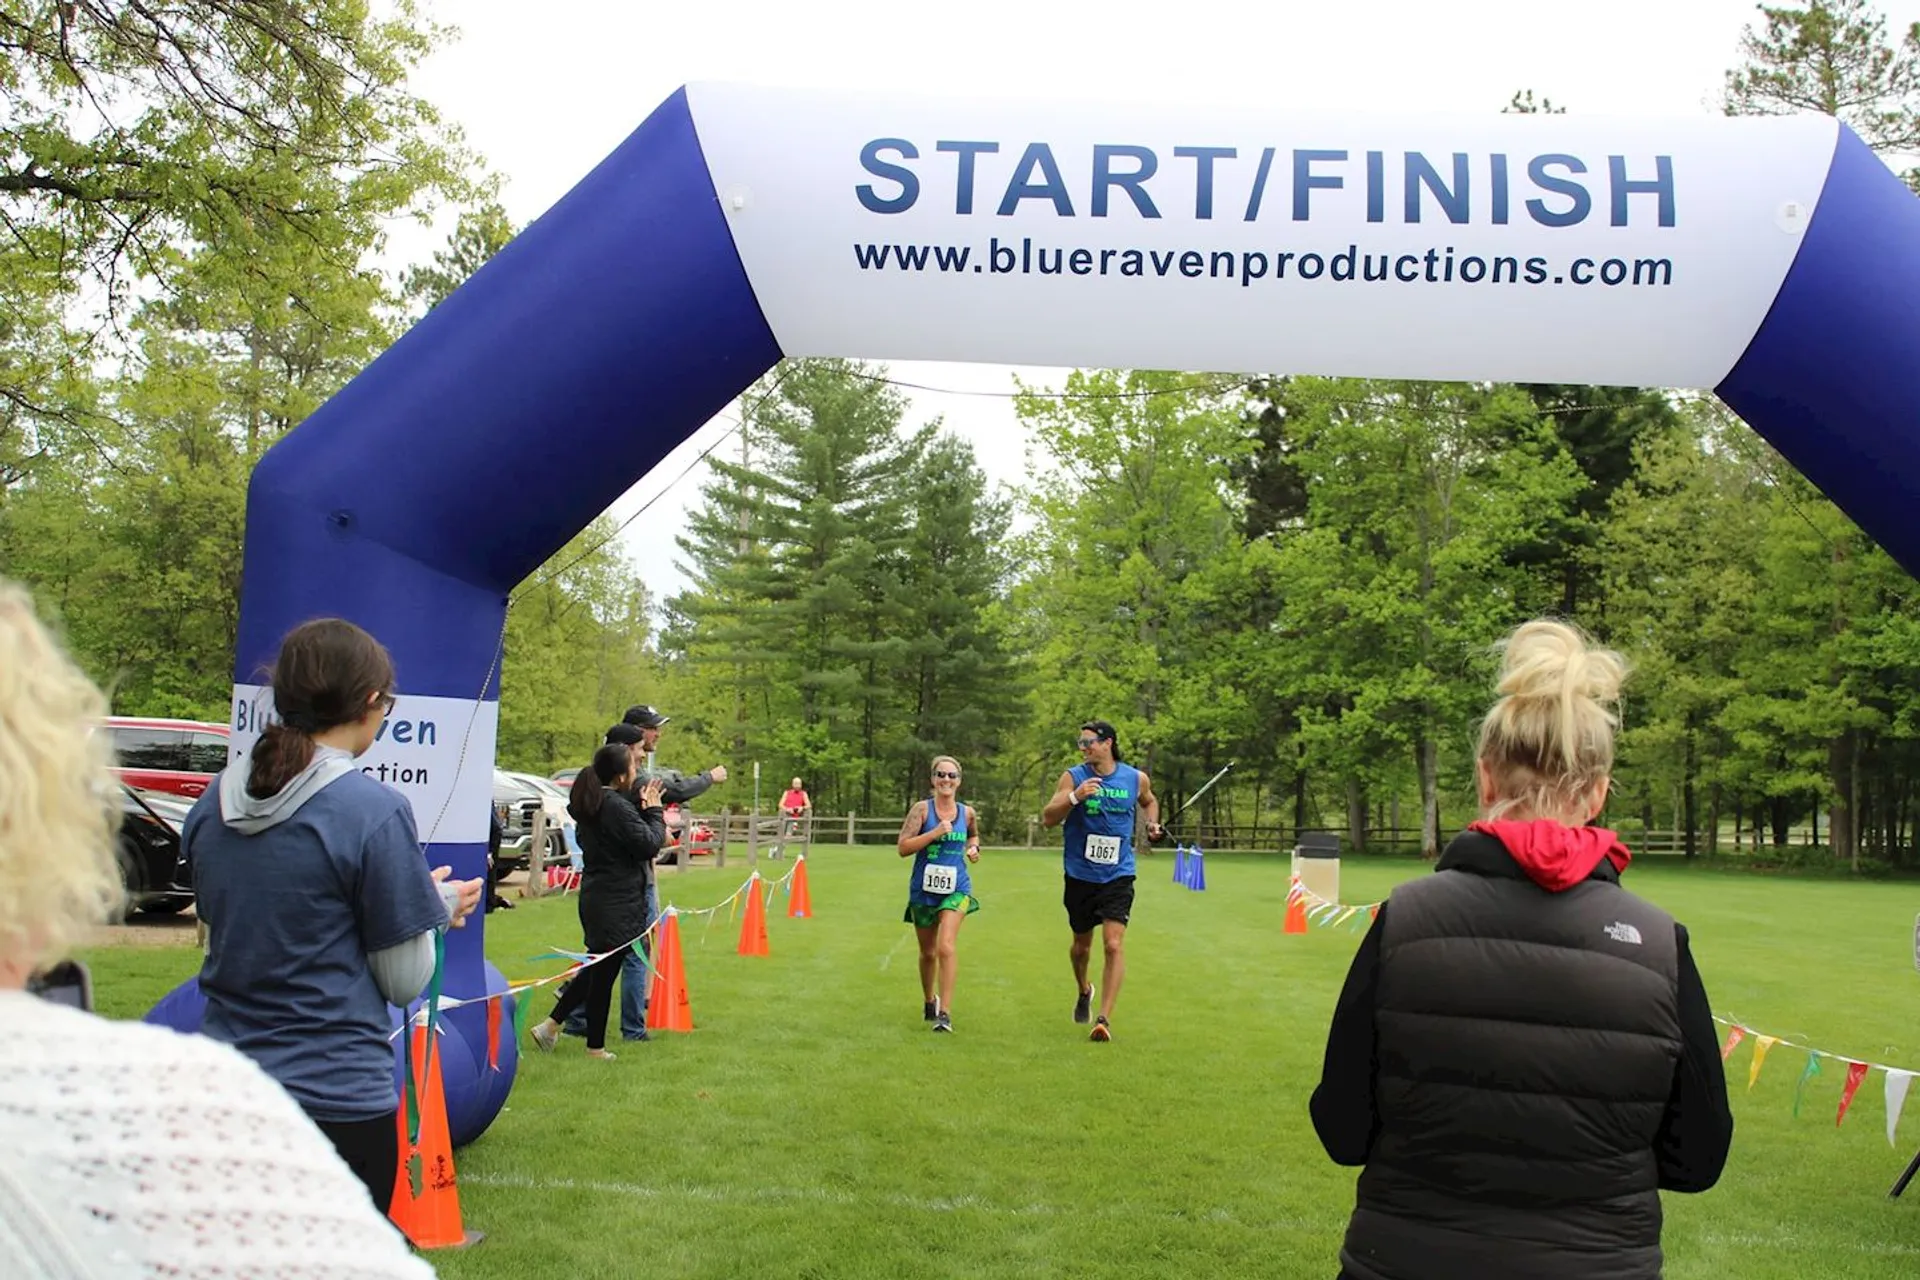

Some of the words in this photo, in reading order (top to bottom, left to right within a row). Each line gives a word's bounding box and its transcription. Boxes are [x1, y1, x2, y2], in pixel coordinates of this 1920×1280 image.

[855, 137, 1676, 229] START/FINISH
[854, 237, 1673, 288] www.blueravenproductions.com
[237, 699, 274, 733] Blu
[375, 719, 436, 746] ven
[1089, 845, 1115, 860] 1067
[927, 874, 952, 890] 1061
